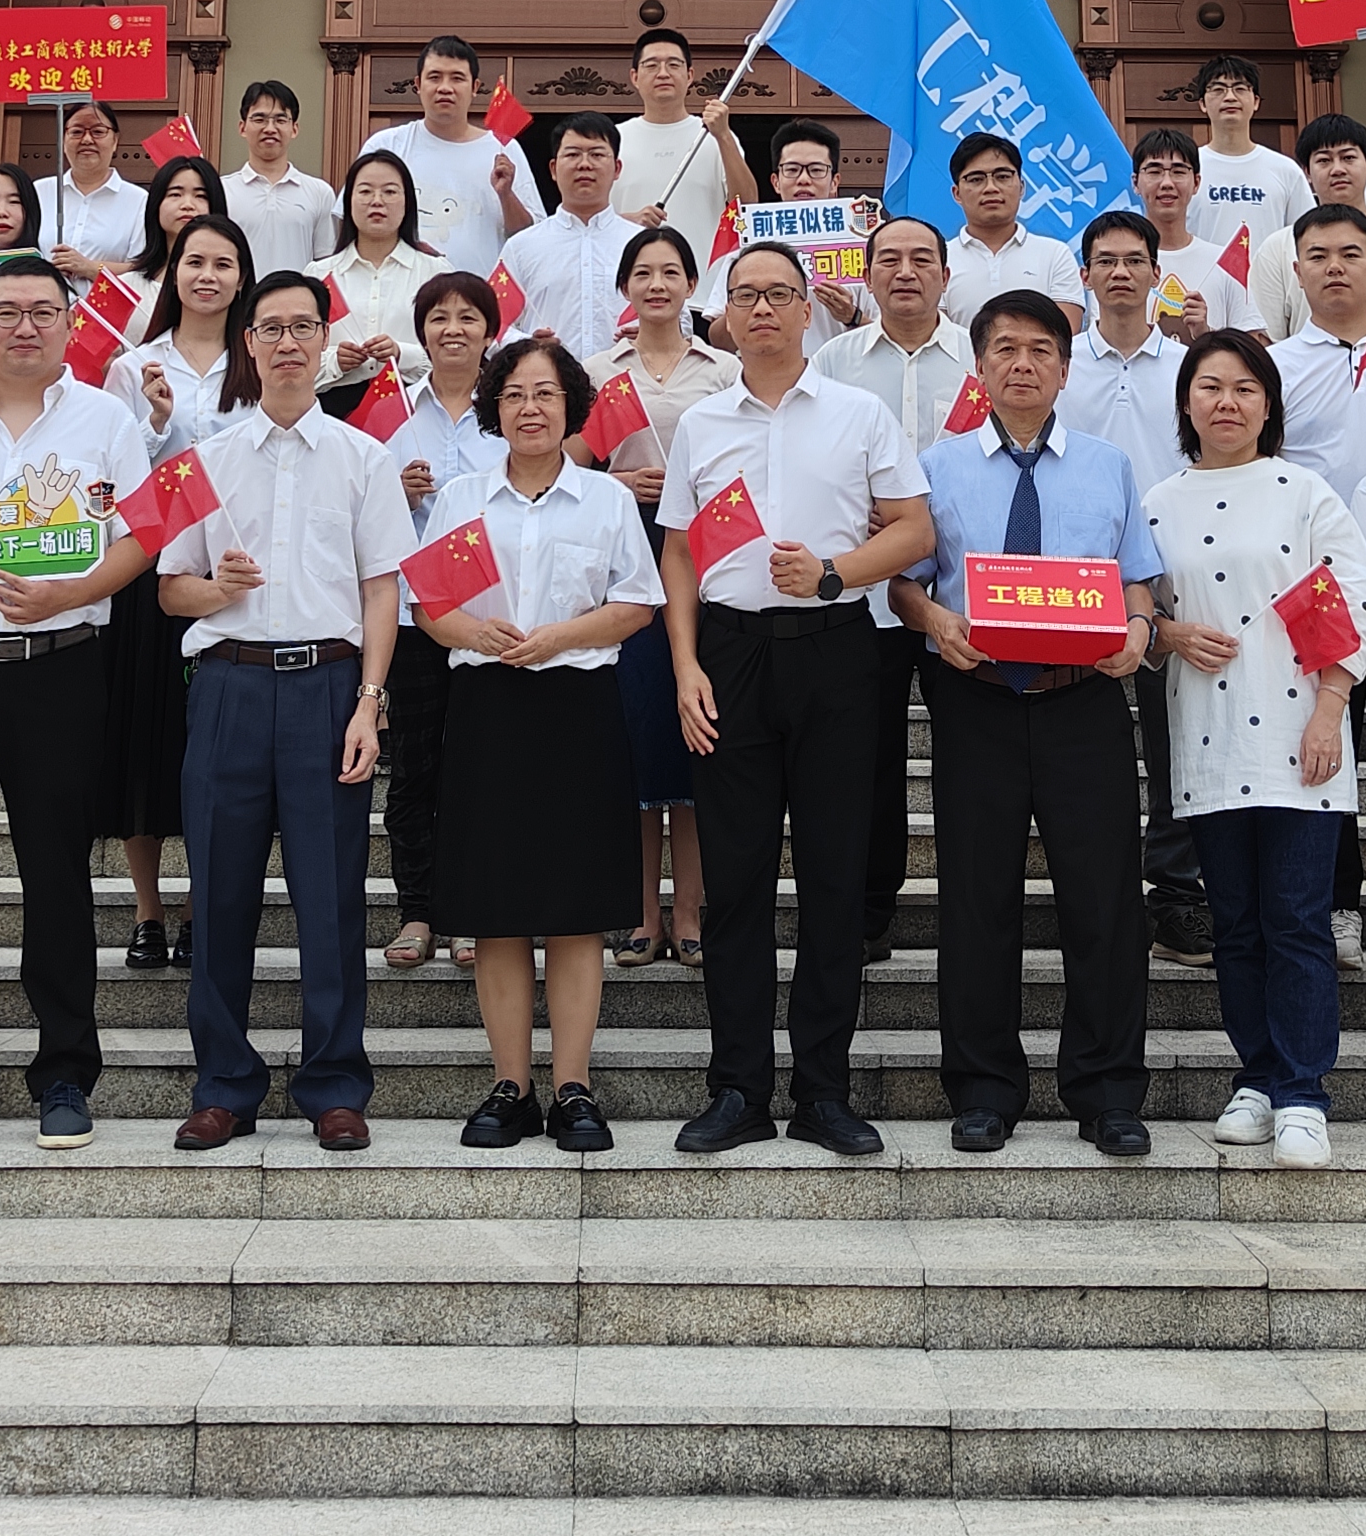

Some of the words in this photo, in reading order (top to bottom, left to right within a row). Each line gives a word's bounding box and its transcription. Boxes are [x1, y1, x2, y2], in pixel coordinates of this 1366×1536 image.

[1208, 185, 1265, 203] GREEN
[751, 205, 846, 238] 前程似锦
[987, 584, 1104, 609] 工程造价
